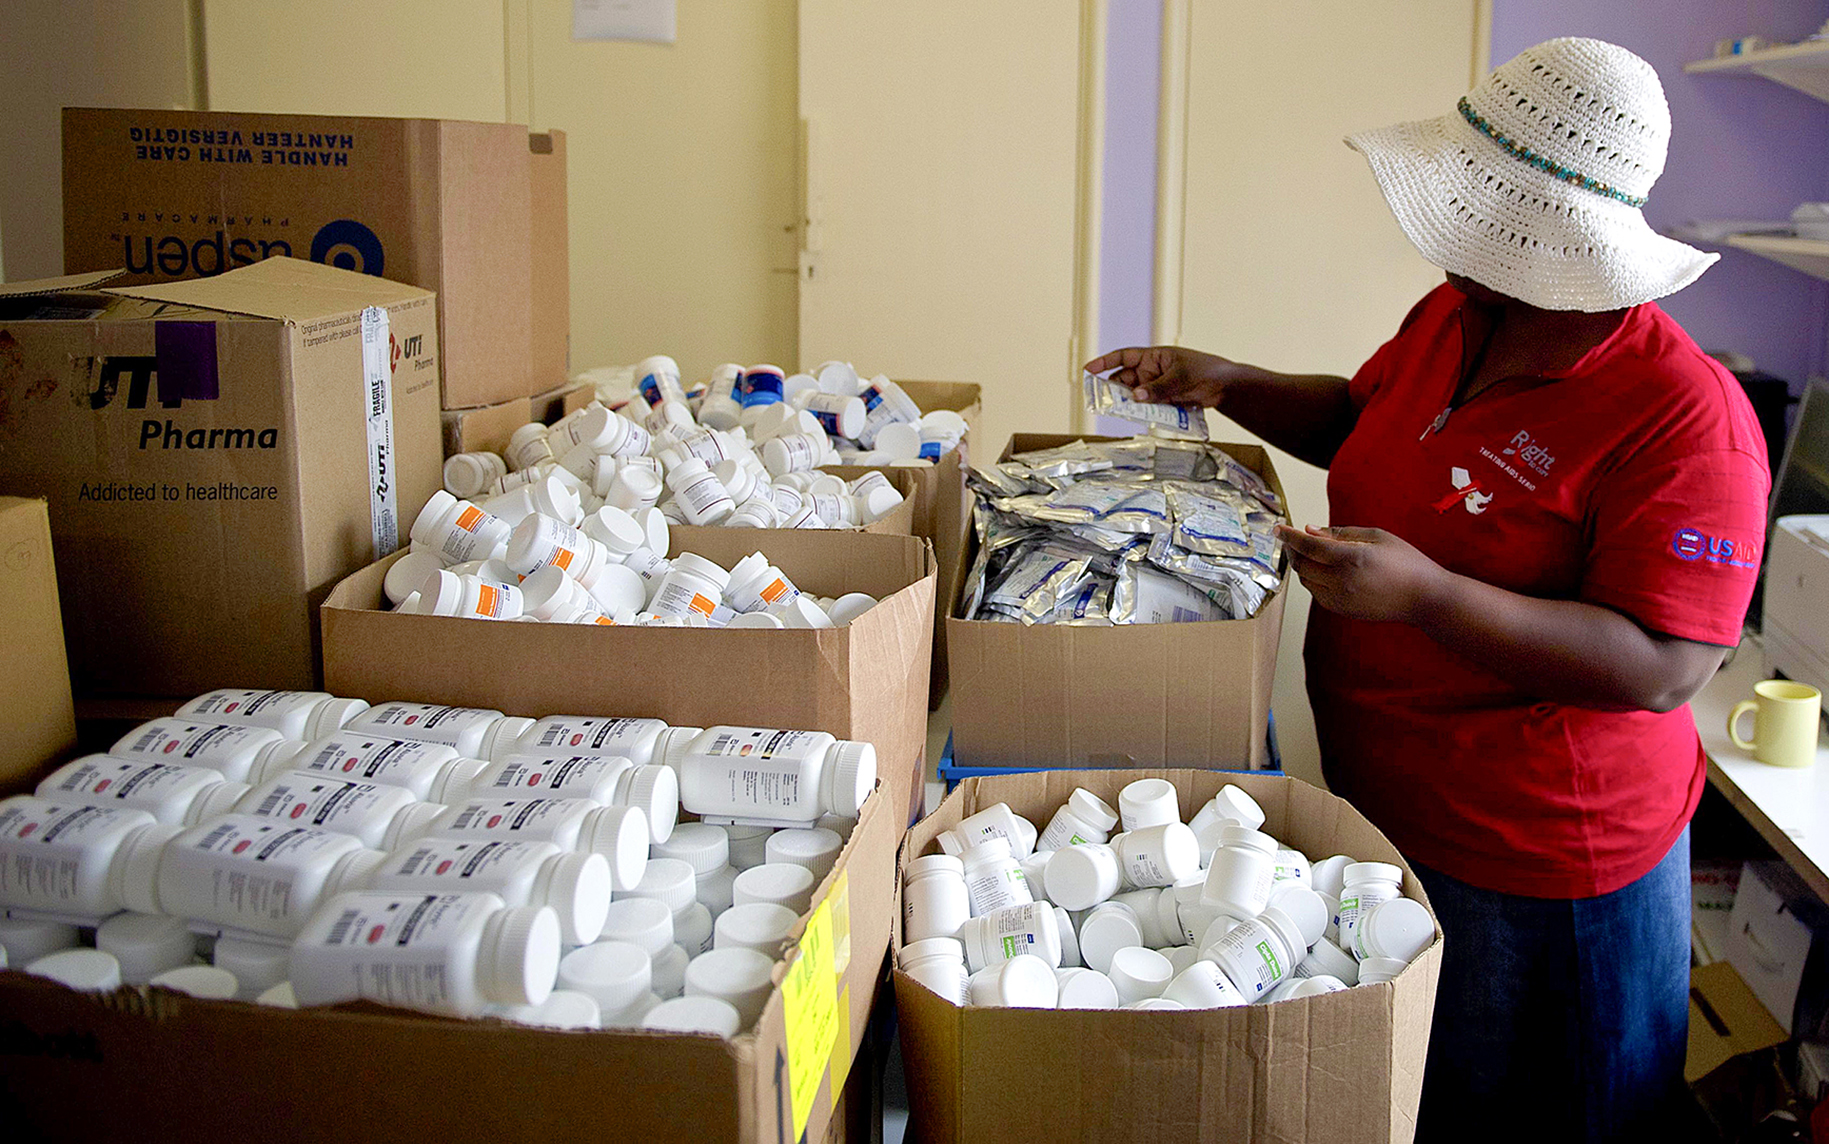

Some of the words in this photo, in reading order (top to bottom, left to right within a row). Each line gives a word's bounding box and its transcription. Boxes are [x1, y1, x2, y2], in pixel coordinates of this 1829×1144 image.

[130, 127, 243, 146] VERSIGTIG
[252, 131, 353, 149] HANTEER
[136, 145, 191, 161] CARE
[200, 148, 252, 163] WITH
[262, 150, 348, 166] HANDLE
[404, 335, 422, 359] UTi
[372, 380, 380, 417] FRAGILE
[139, 420, 278, 449] Pharma
[1510, 430, 1556, 470] Right
[1504, 465, 1519, 479] AIDS
[79, 483, 155, 501] Addicted
[162, 483, 180, 501] to
[186, 482, 278, 501] healthcare
